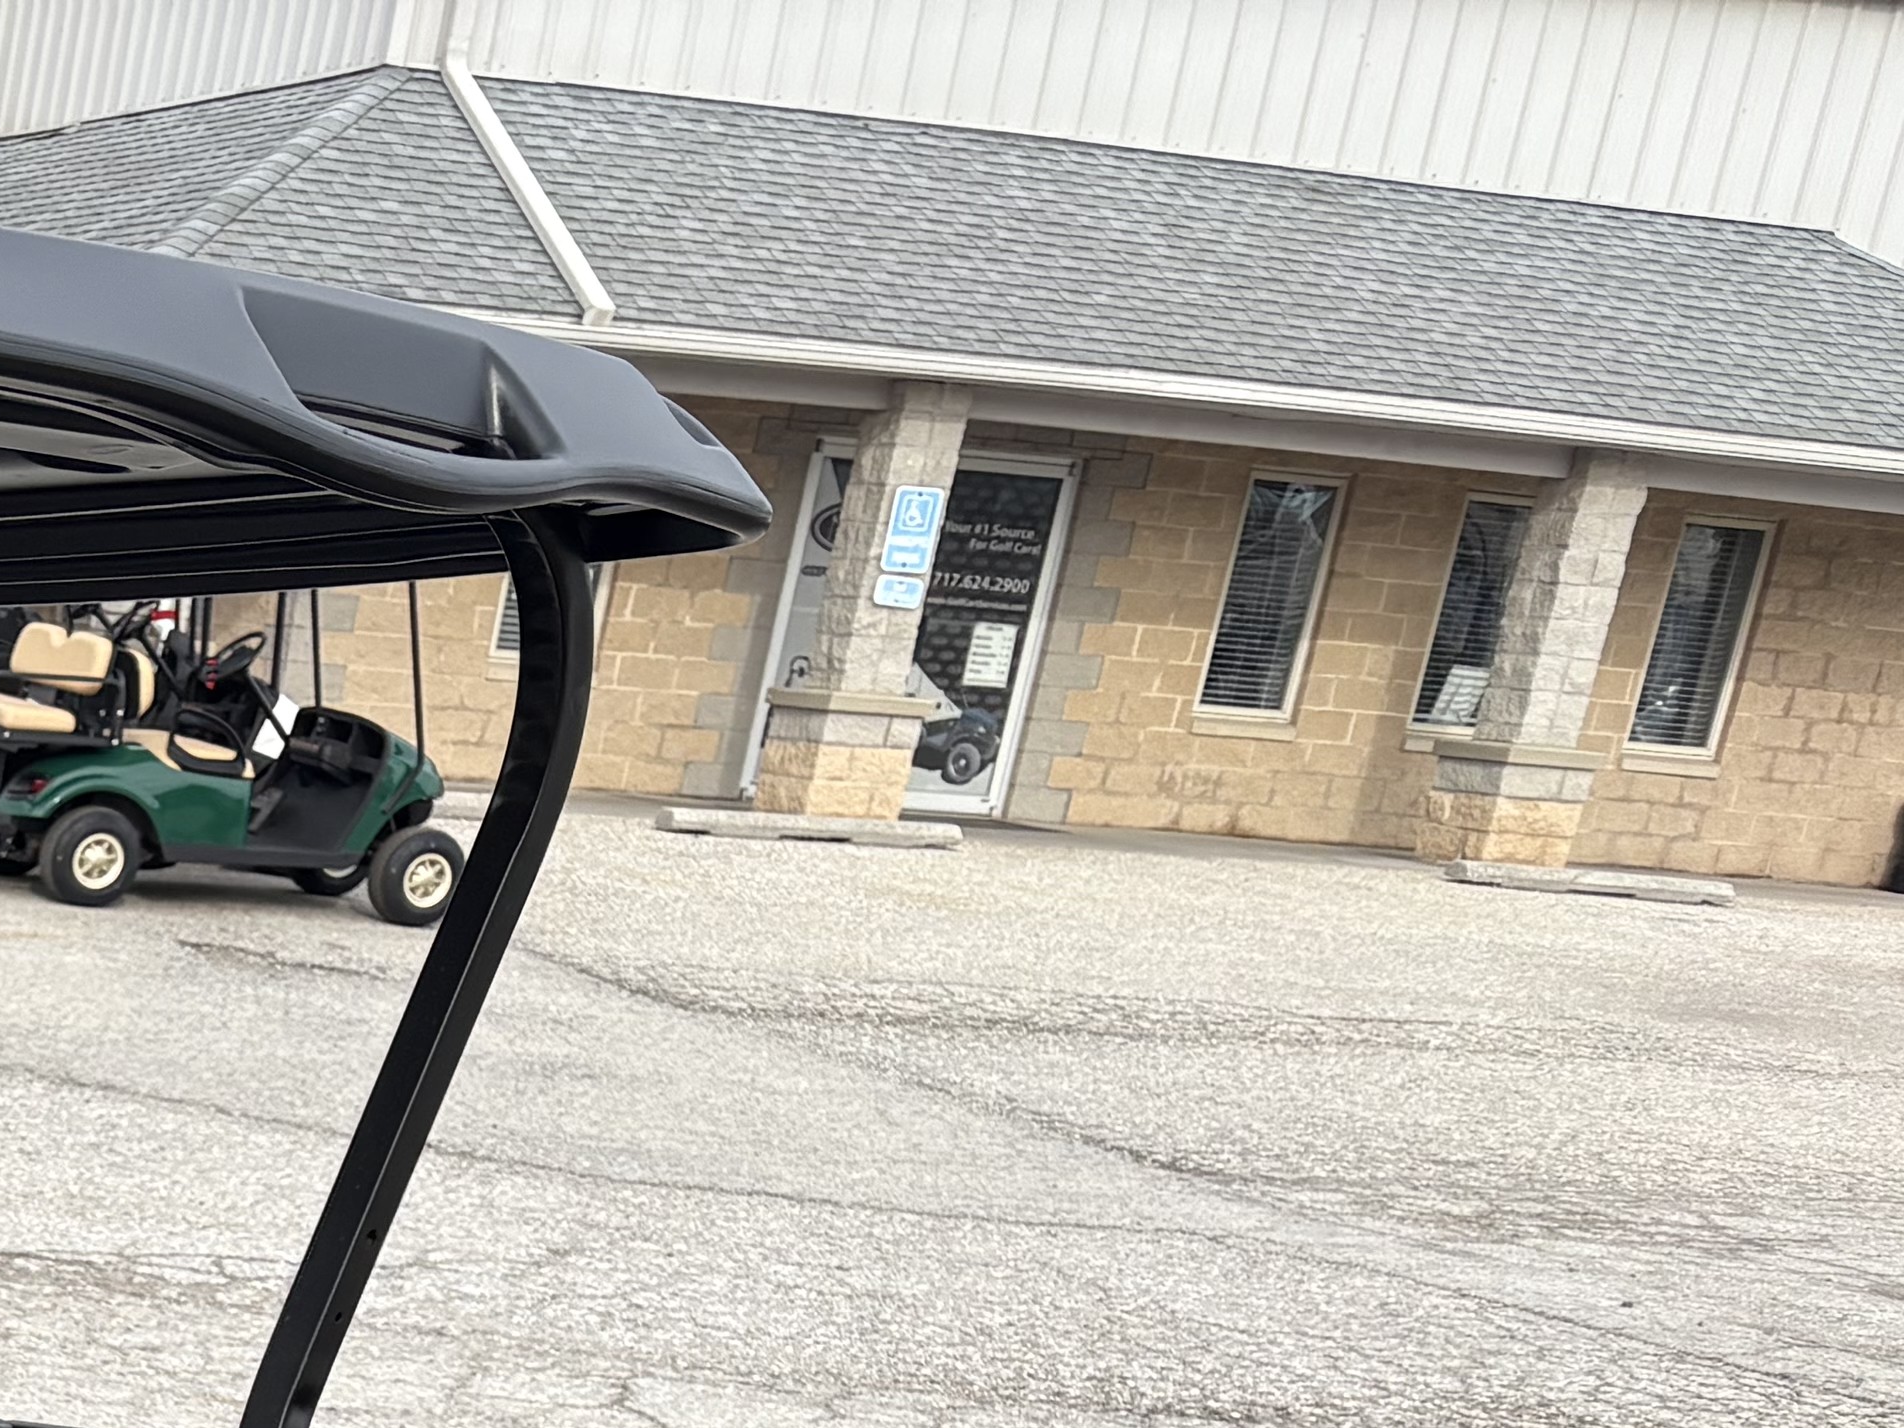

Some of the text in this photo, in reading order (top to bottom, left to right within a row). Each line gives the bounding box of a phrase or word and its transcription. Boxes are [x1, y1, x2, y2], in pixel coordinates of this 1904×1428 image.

[974, 523, 989, 535] #1
[991, 523, 1036, 540] Source
[968, 537, 988, 550] For
[932, 572, 1031, 594] 717.624.2900
